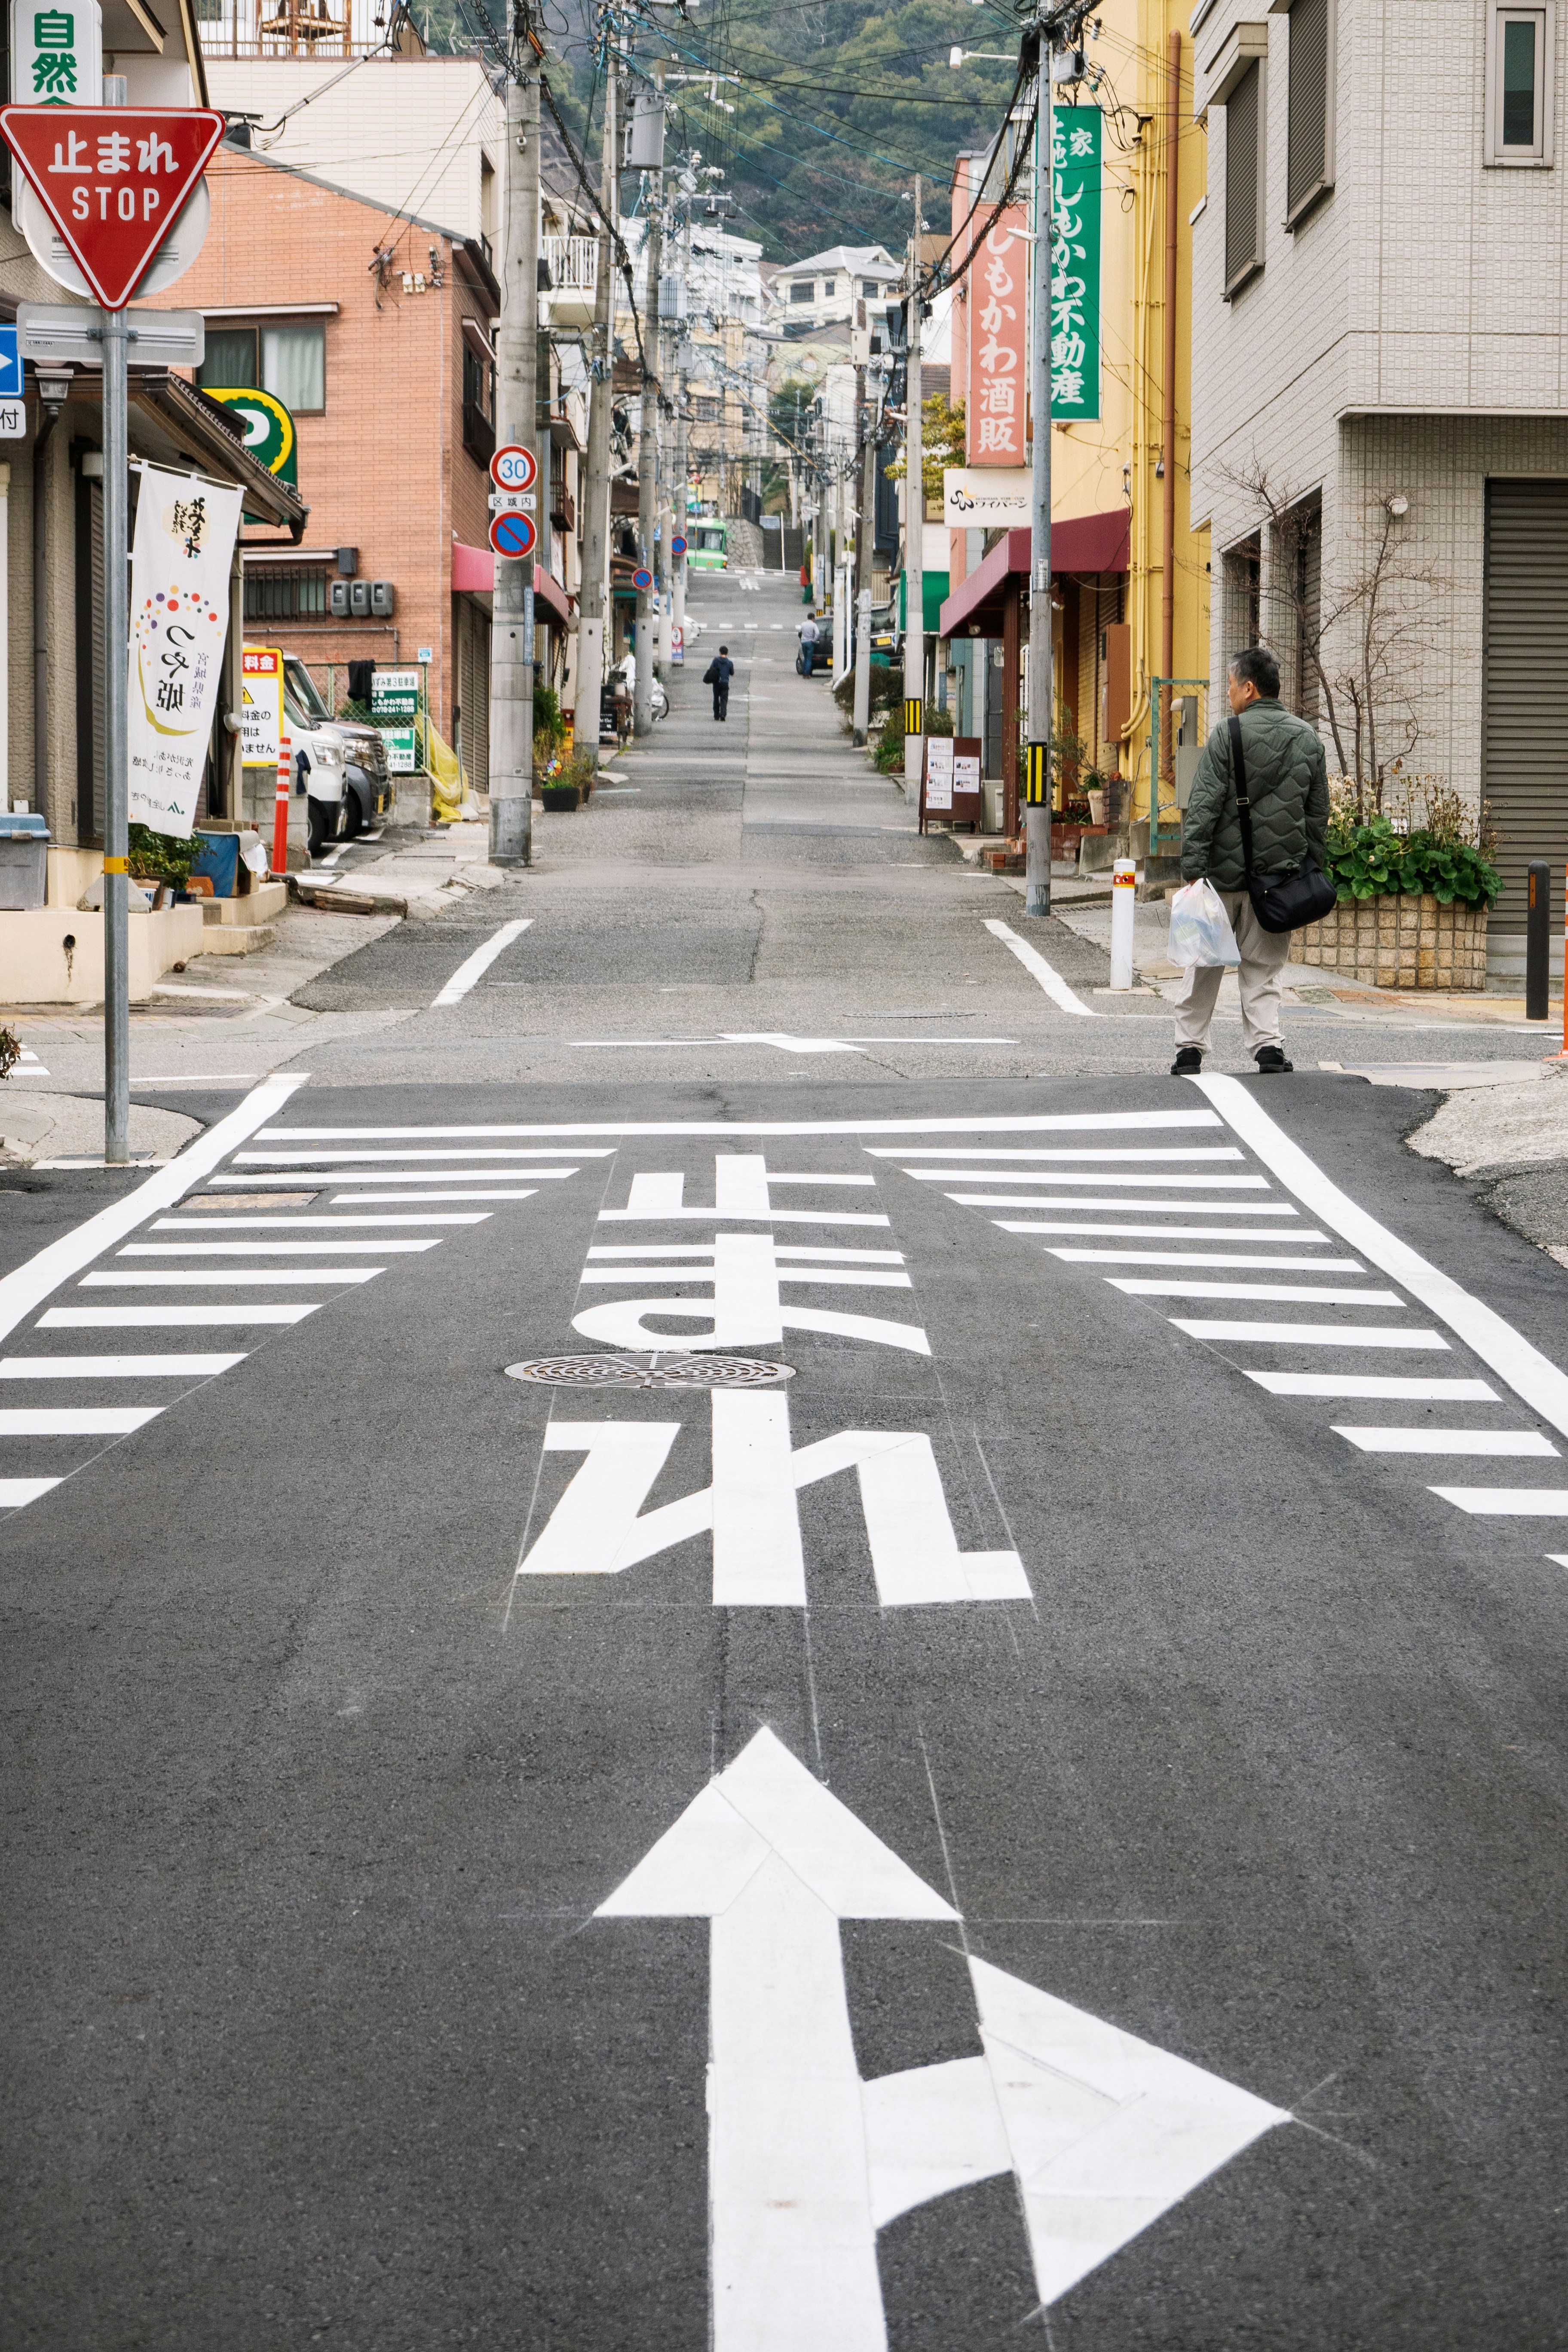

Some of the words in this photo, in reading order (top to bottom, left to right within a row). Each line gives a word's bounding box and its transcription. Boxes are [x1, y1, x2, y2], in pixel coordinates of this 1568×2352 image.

[31, 9, 77, 105] 自然
[48, 130, 179, 175] 止まれ
[72, 186, 160, 221] STOP
[1051, 173, 1086, 404] しもかわ不動産
[978, 216, 1017, 454] しもかわ酒販
[0, 408, 19, 429] 付
[502, 459, 526, 479] 30
[493, 496, 531, 507] 区域内
[517, 1155, 1032, 1607] 止まれ
